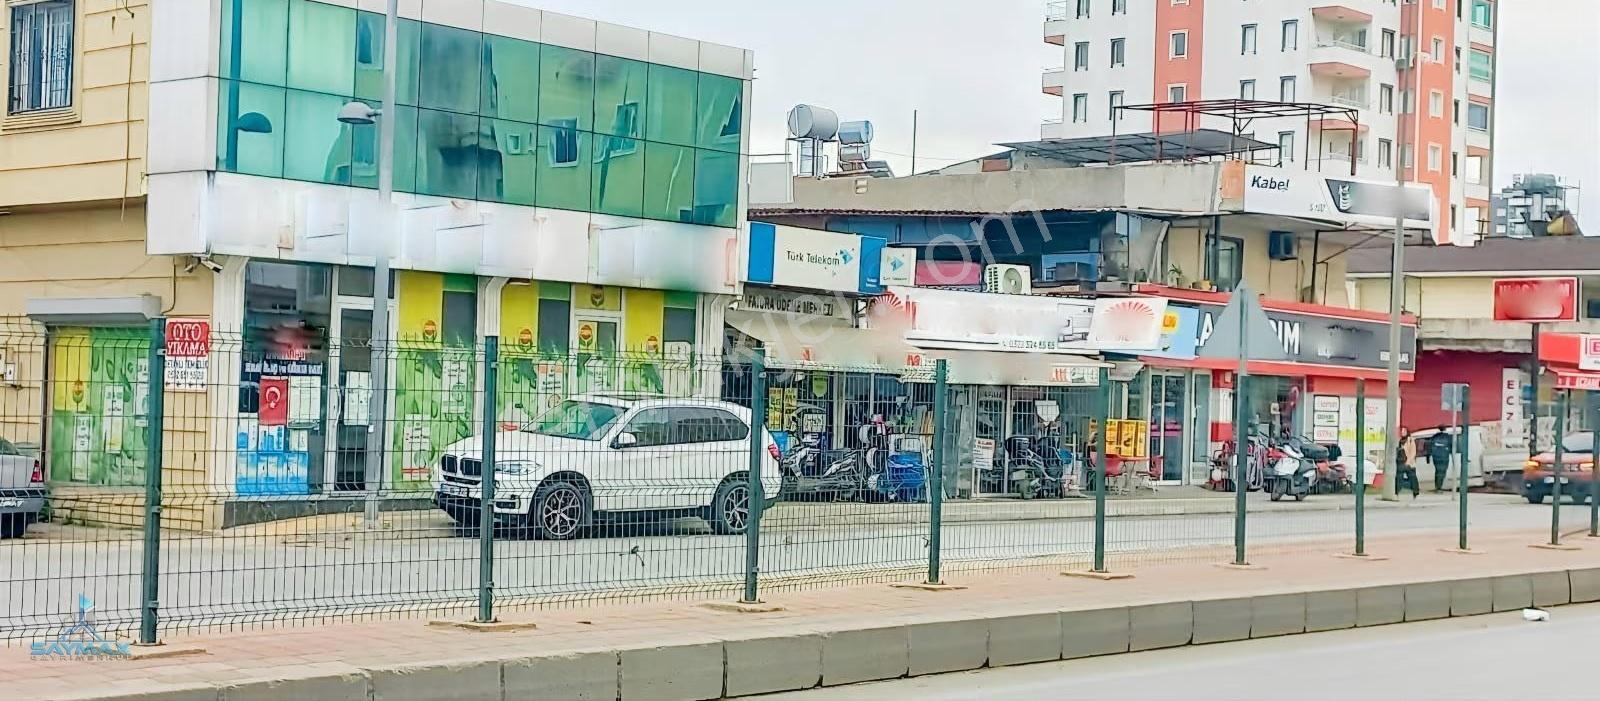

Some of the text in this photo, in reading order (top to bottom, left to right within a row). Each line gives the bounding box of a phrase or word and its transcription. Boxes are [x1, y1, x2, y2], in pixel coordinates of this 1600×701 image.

[786, 251, 840, 266] Türk Telekom
[173, 323, 201, 341] OTO
[167, 341, 207, 355] YIKAMA
